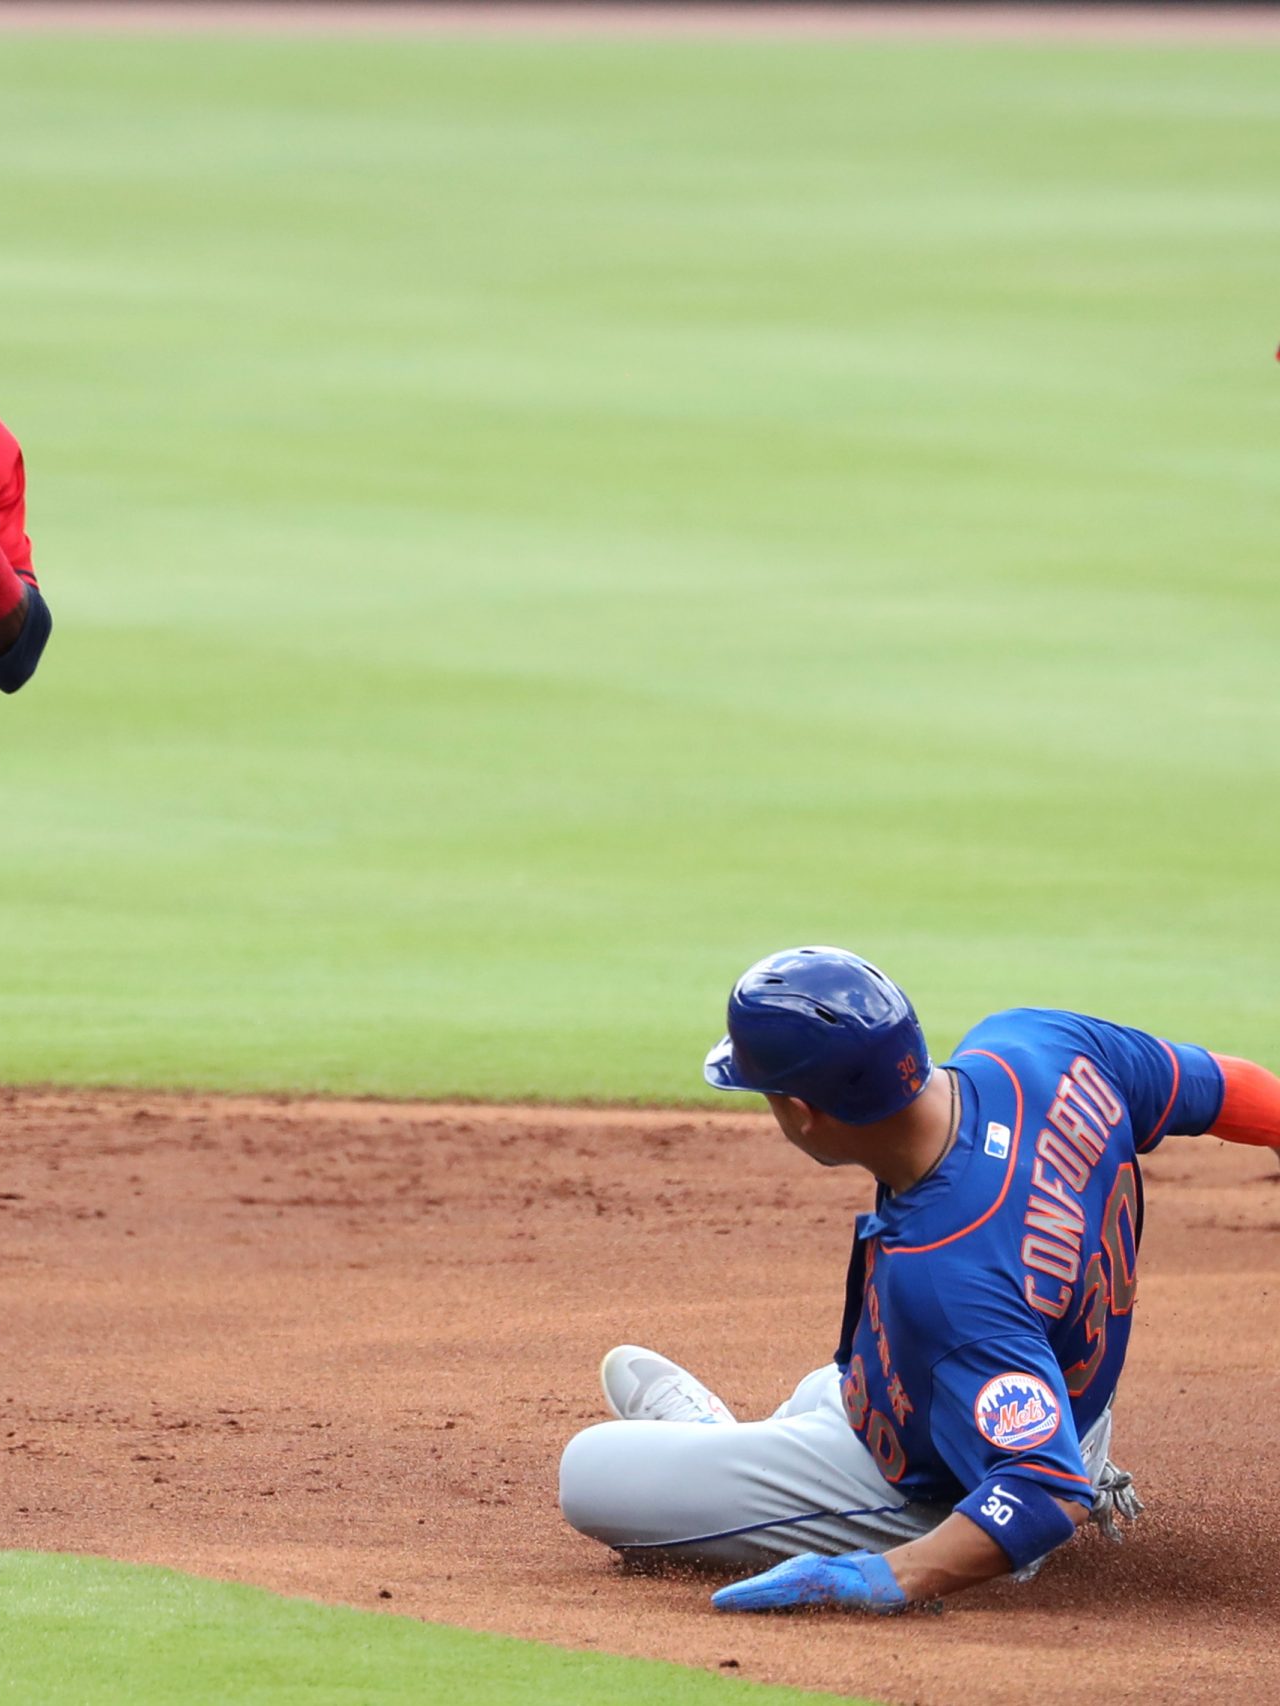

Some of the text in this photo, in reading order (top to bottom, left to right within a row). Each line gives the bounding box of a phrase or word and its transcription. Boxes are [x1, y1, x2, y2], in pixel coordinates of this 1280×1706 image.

[896, 1054, 917, 1081] 30
[1020, 1054, 1124, 1320] CONFORTO
[1062, 1161, 1137, 1397] 30
[841, 1353, 907, 1484] 30
[993, 1397, 1047, 1437] Mets
[980, 1494, 1014, 1527] 30
